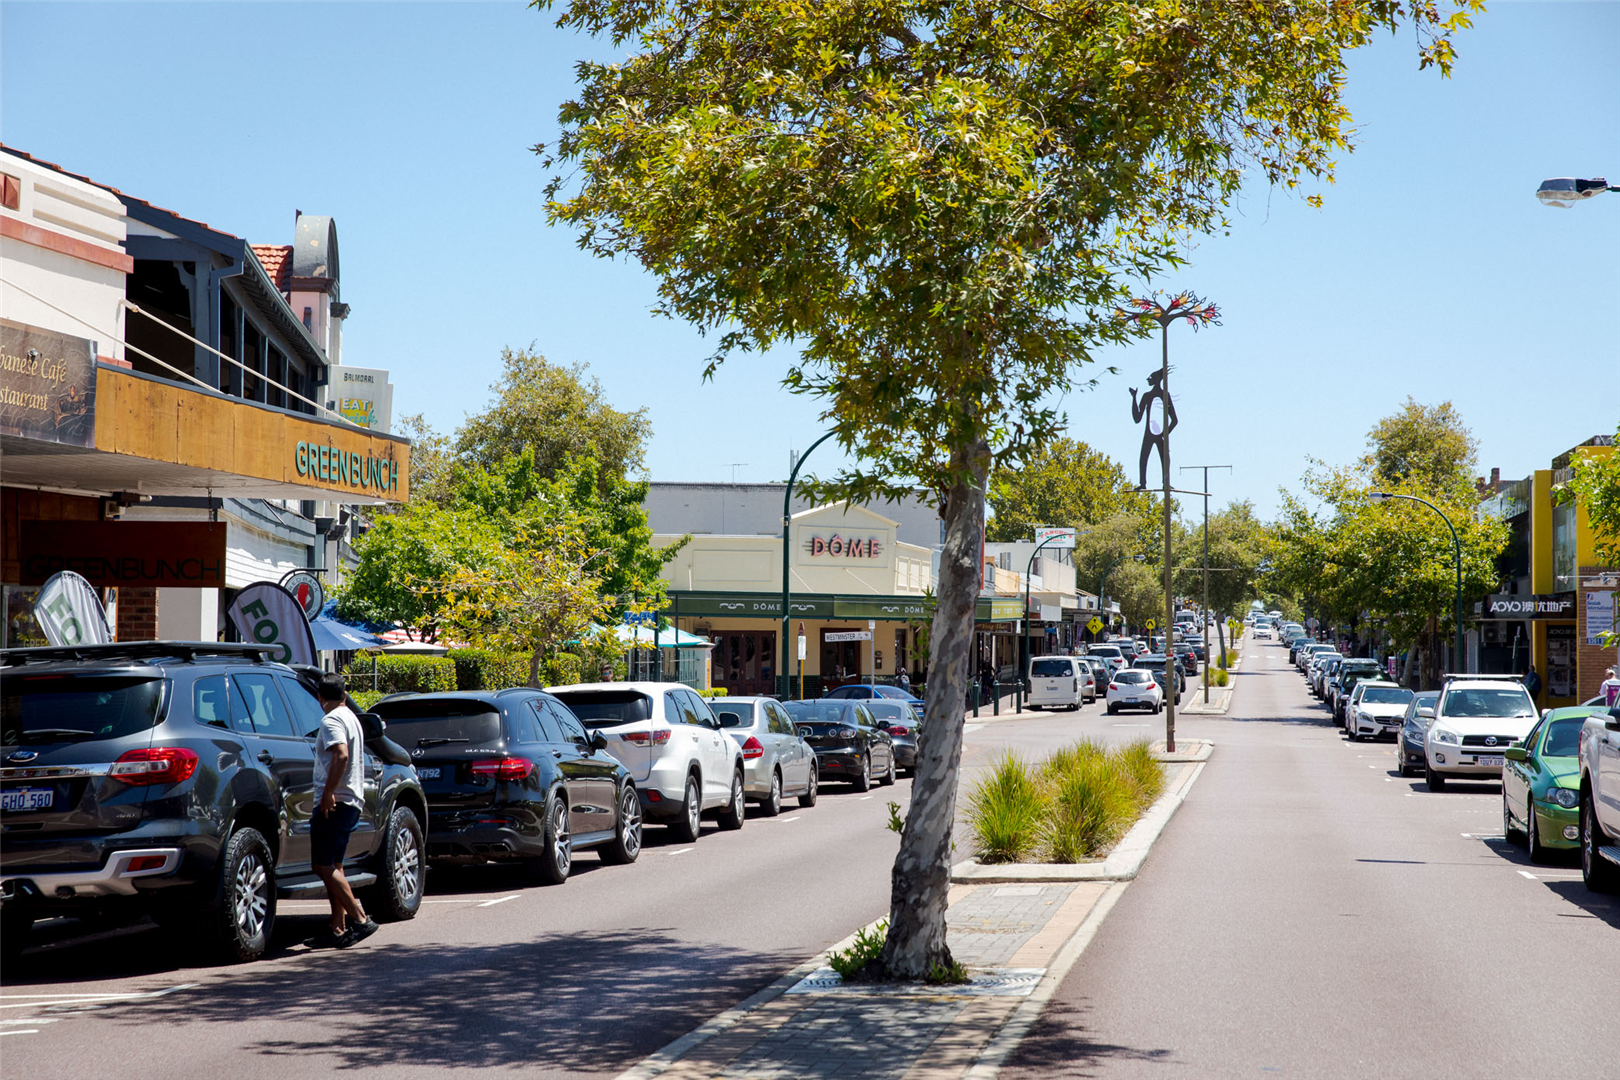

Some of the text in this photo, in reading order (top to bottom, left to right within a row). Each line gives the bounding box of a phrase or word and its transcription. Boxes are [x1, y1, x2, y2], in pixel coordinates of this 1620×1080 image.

[41, 357, 67, 389] Café
[343, 372, 374, 384] BALMORAL
[295, 440, 398, 492] GREENBUNCH
[811, 534, 880, 559] DÔME
[753, 602, 782, 611] DÔME
[904, 606, 925, 614] DÔME
[240, 597, 299, 665] FOO
